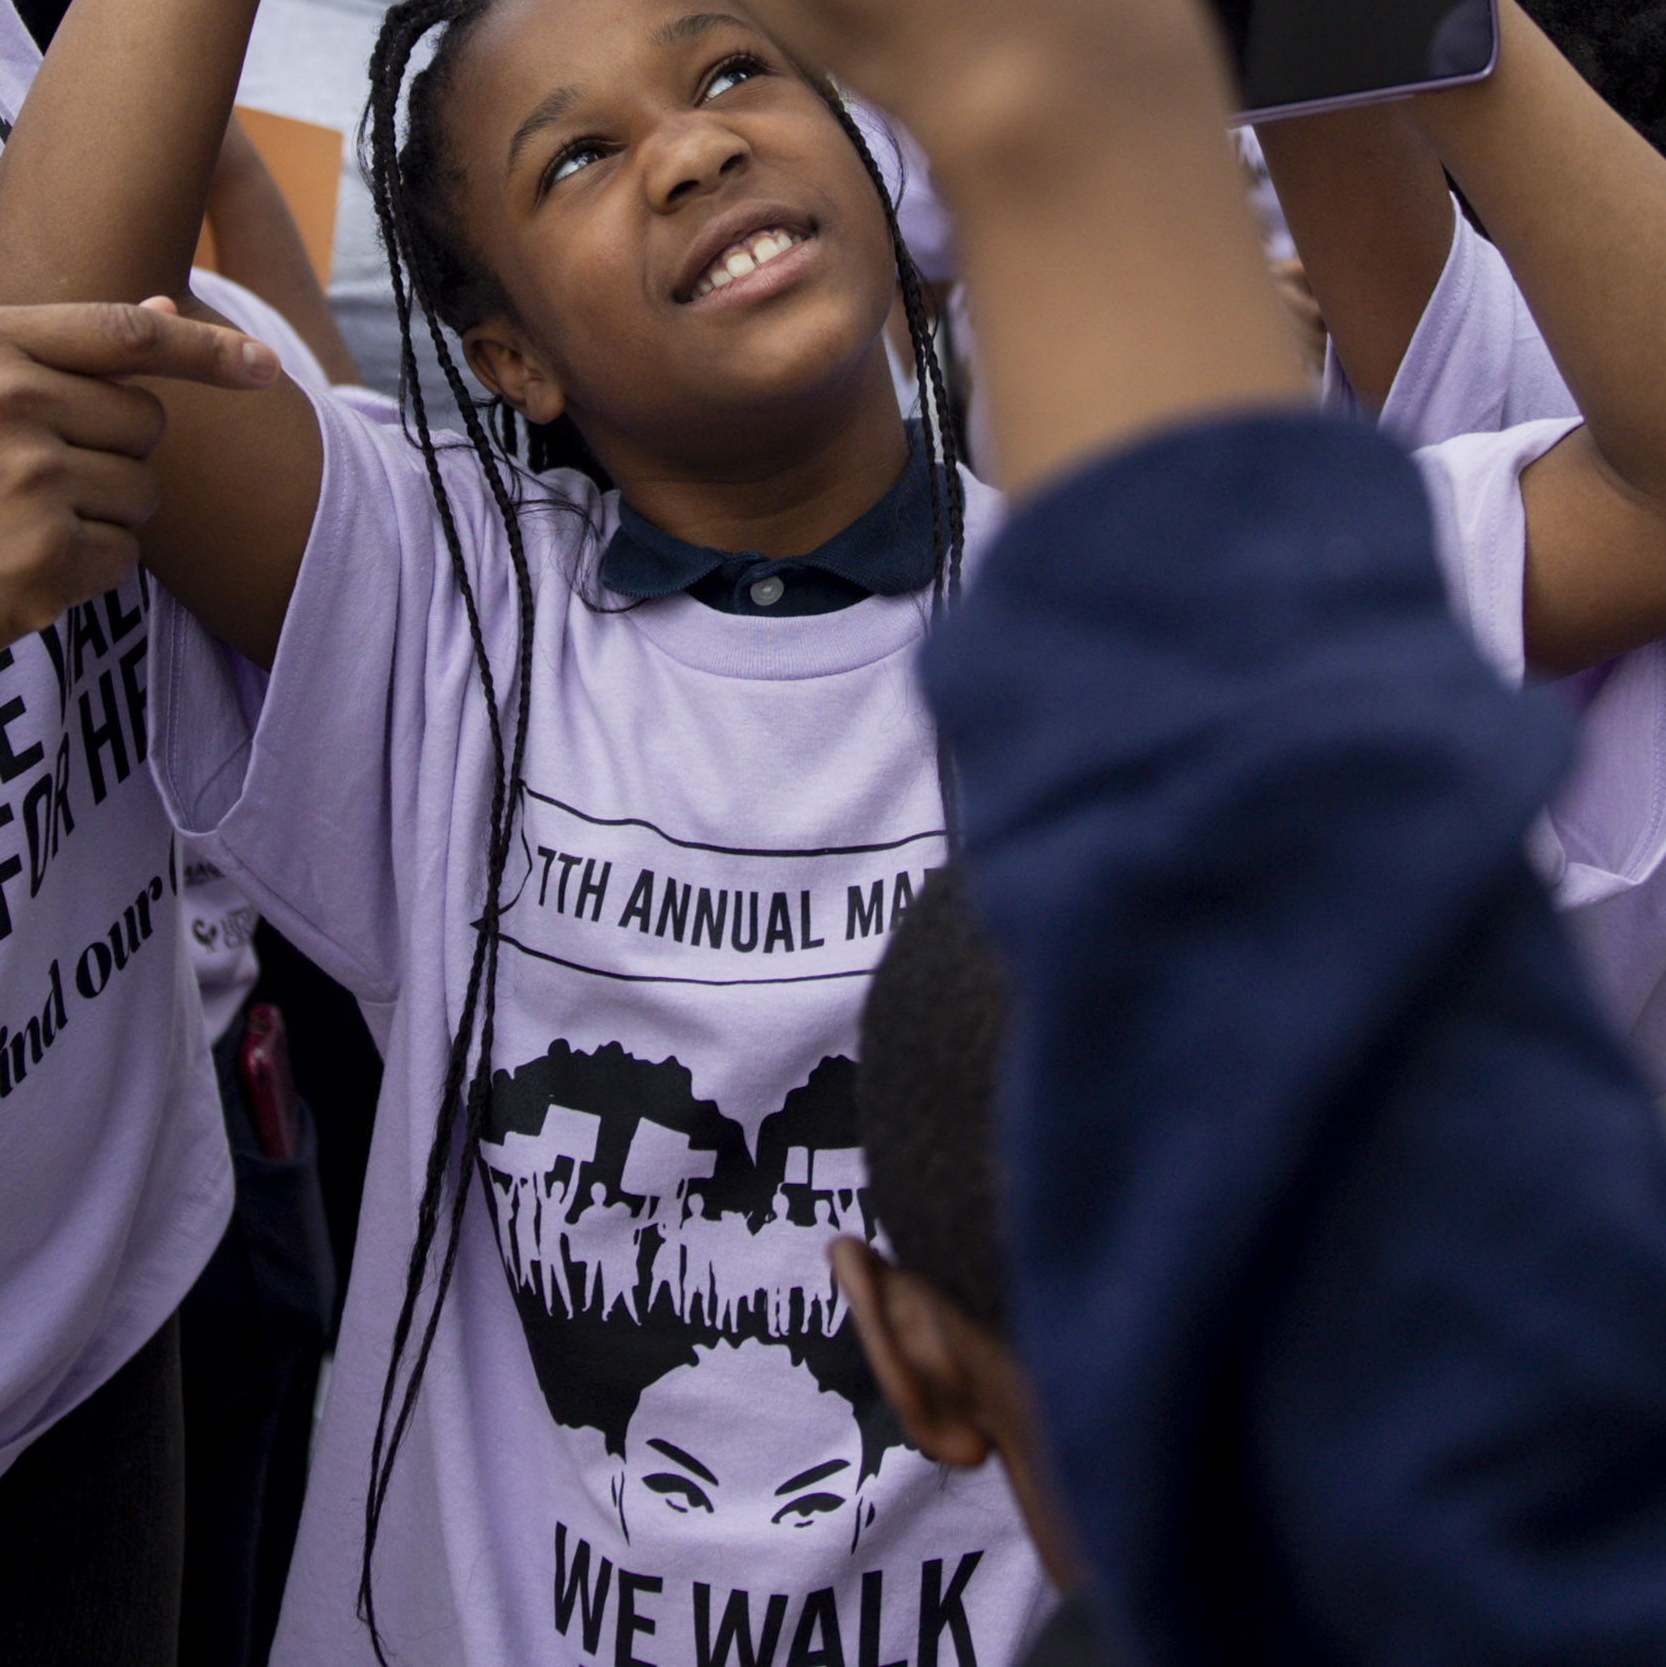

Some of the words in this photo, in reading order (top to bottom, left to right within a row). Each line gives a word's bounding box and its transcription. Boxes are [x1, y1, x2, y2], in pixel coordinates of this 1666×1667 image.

[75, 877, 163, 1000] our
[538, 845, 613, 923] 7TH
[618, 868, 825, 954] ANNUAL
[554, 1520, 663, 1667] WE
[692, 1550, 985, 1667] WALK
